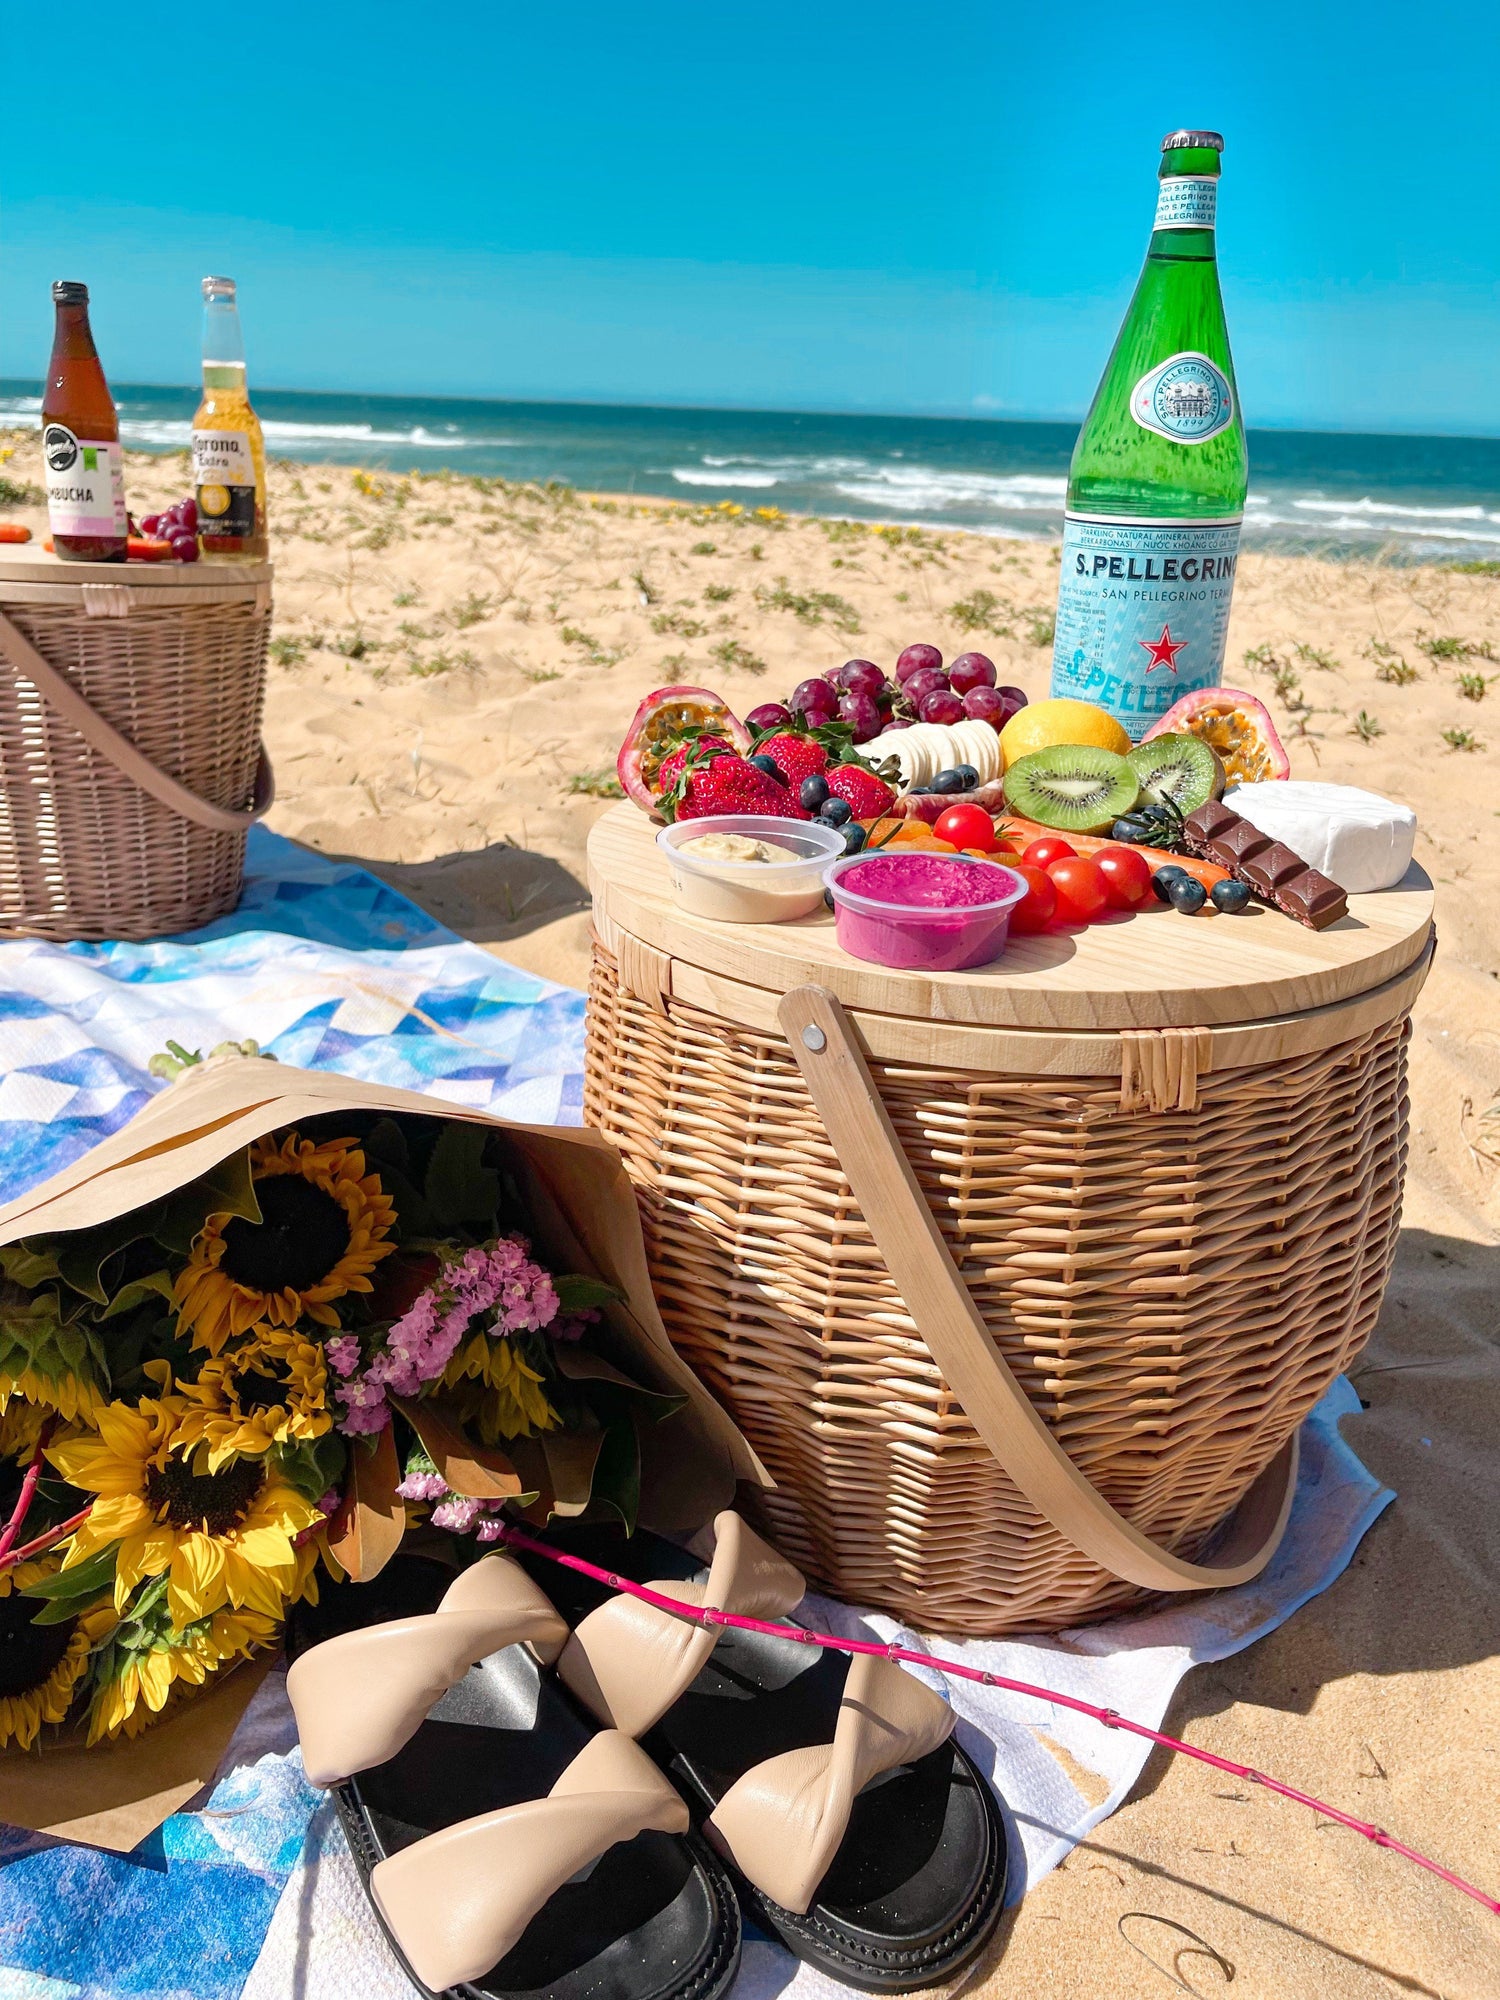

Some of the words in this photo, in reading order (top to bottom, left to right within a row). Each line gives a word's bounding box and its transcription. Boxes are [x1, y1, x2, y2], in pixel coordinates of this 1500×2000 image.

[1158, 366, 1212, 395] PELLEGRINO
[1158, 400, 1169, 419] SAN
[1176, 419, 1204, 427] 1899
[1116, 532, 1152, 541] NATURAL
[1156, 533, 1190, 541] MINERAL
[1193, 532, 1216, 541] WATER
[1101, 588, 1128, 600] SAN
[1133, 590, 1207, 601] PELLEGRINO
